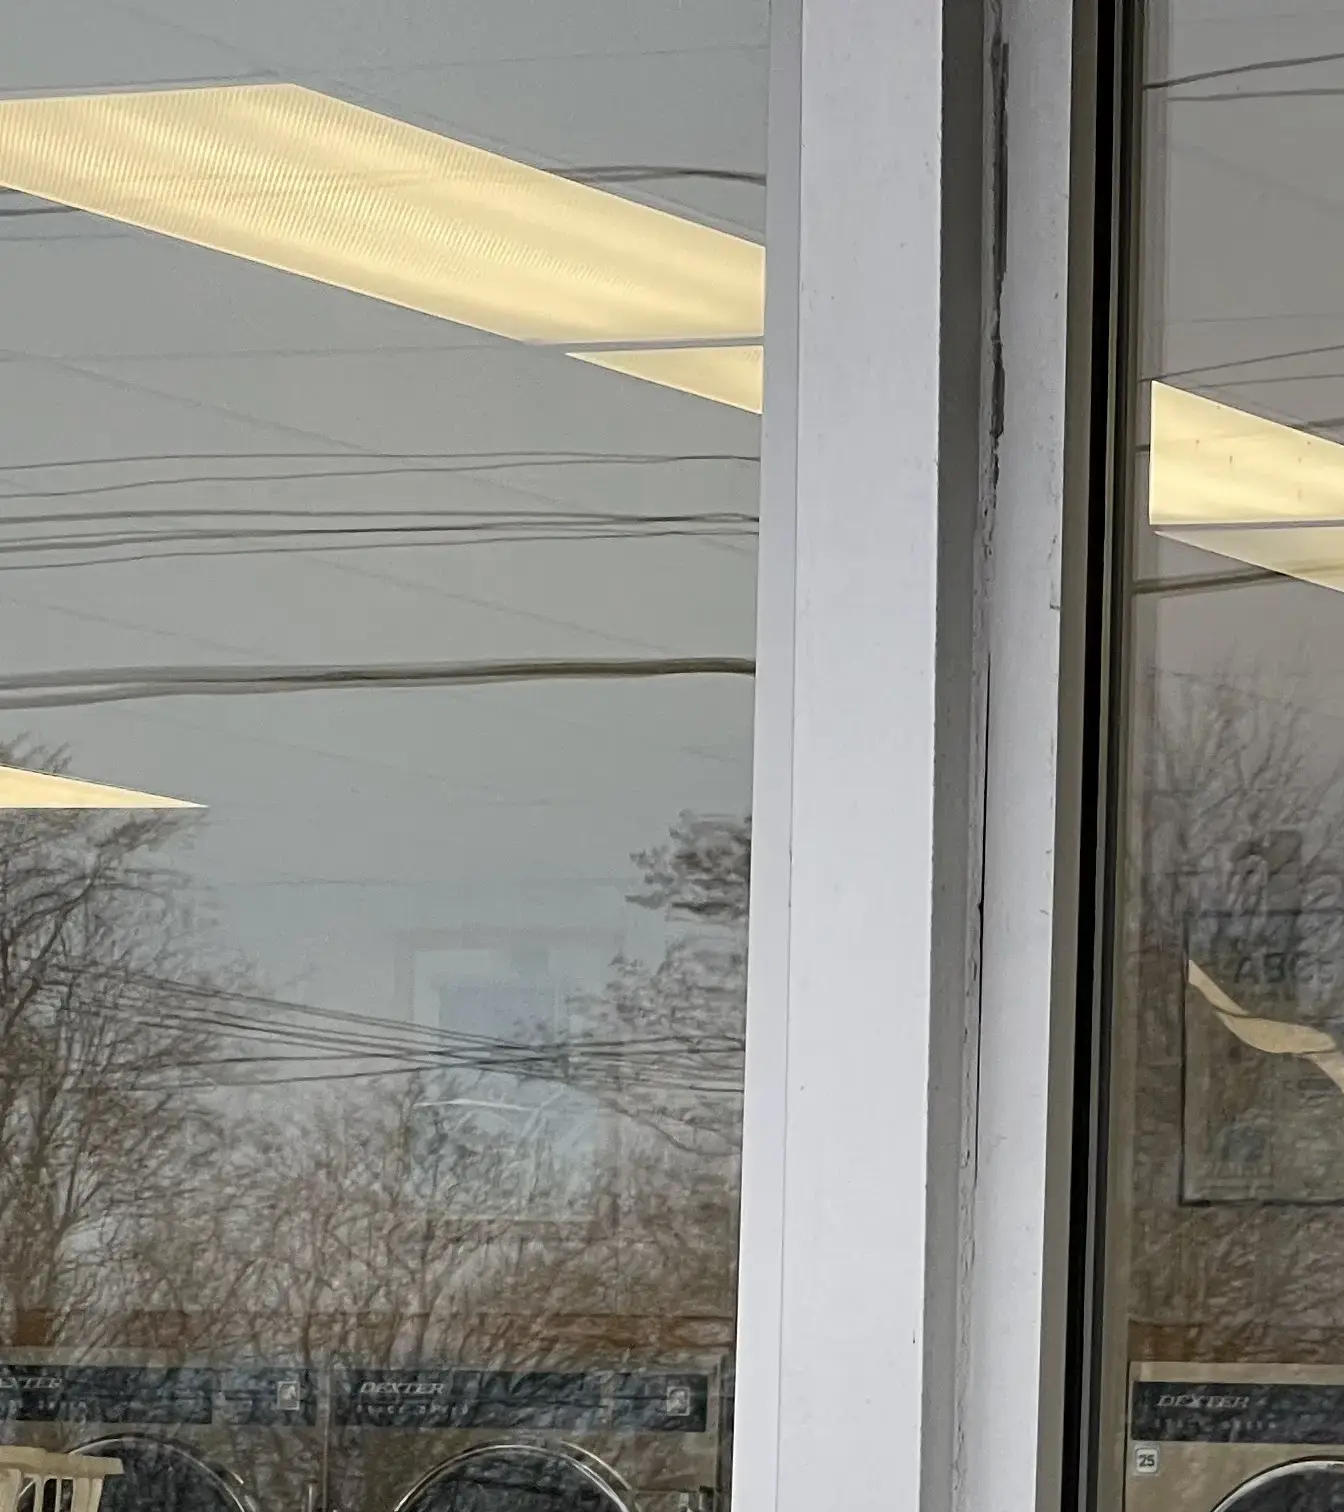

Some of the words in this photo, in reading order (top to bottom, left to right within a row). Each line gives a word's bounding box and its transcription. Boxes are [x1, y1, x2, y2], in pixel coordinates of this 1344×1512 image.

[358, 1381, 445, 1395] DEXTER
[1156, 1393, 1251, 1409] DEXTER
[1137, 1453, 1156, 1468] 25
